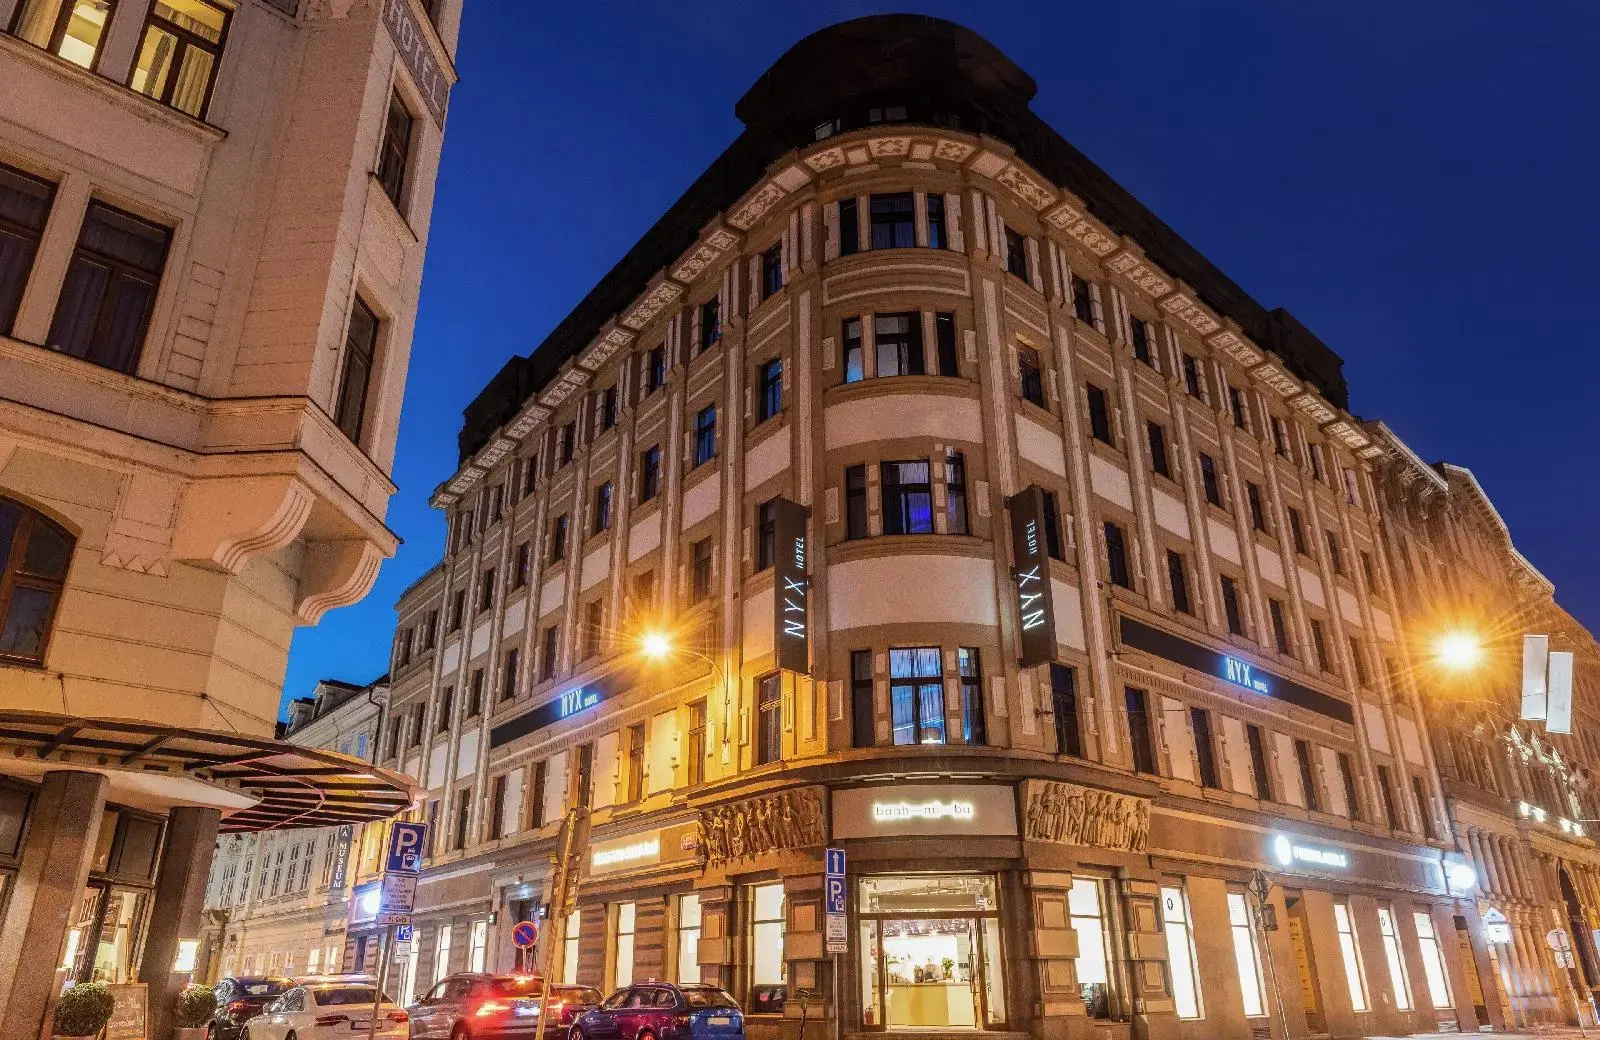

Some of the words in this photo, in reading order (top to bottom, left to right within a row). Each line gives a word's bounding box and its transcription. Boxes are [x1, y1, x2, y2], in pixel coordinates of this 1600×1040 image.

[389, 0, 440, 113] HOTEL
[1026, 519, 1038, 555] HOTEL
[784, 575, 805, 639] NYX
[795, 536, 804, 569] HOTEL
[1019, 565, 1045, 630] NYX
[1226, 657, 1252, 687] NYX
[561, 688, 582, 717] NYX
[395, 827, 418, 857] P
[332, 842, 348, 888] MUSEUM
[830, 880, 842, 902] P
